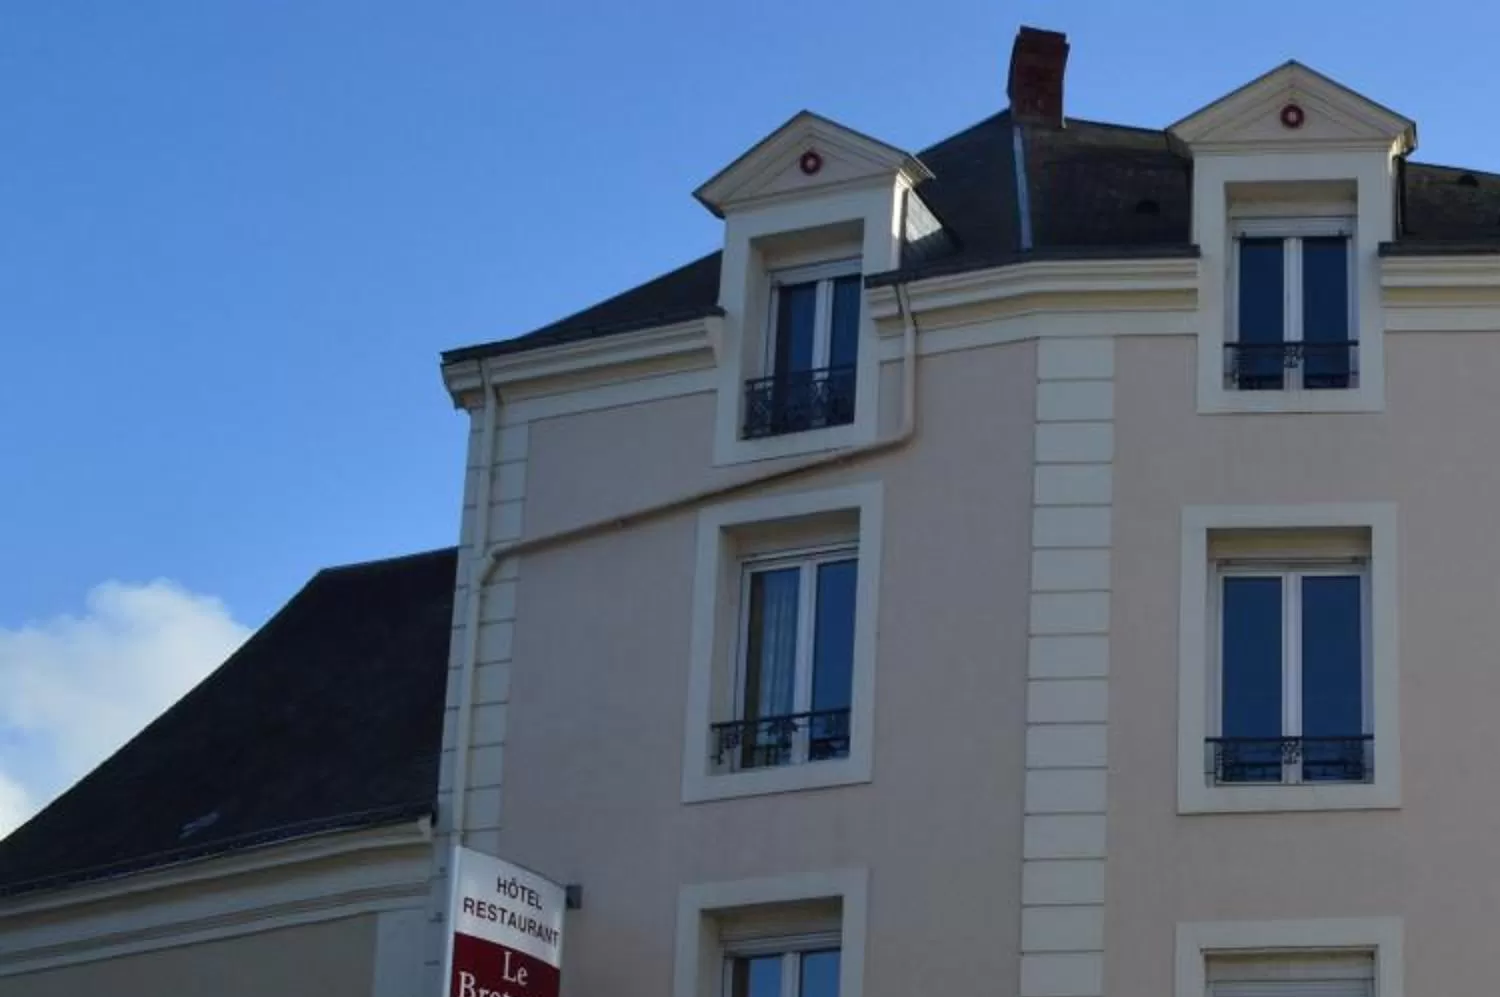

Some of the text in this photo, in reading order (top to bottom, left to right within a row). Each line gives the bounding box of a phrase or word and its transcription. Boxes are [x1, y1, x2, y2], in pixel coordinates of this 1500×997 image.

[496, 876, 543, 910] HÔTEL
[463, 897, 560, 949] RESTAURANT
[502, 952, 528, 986] Le
